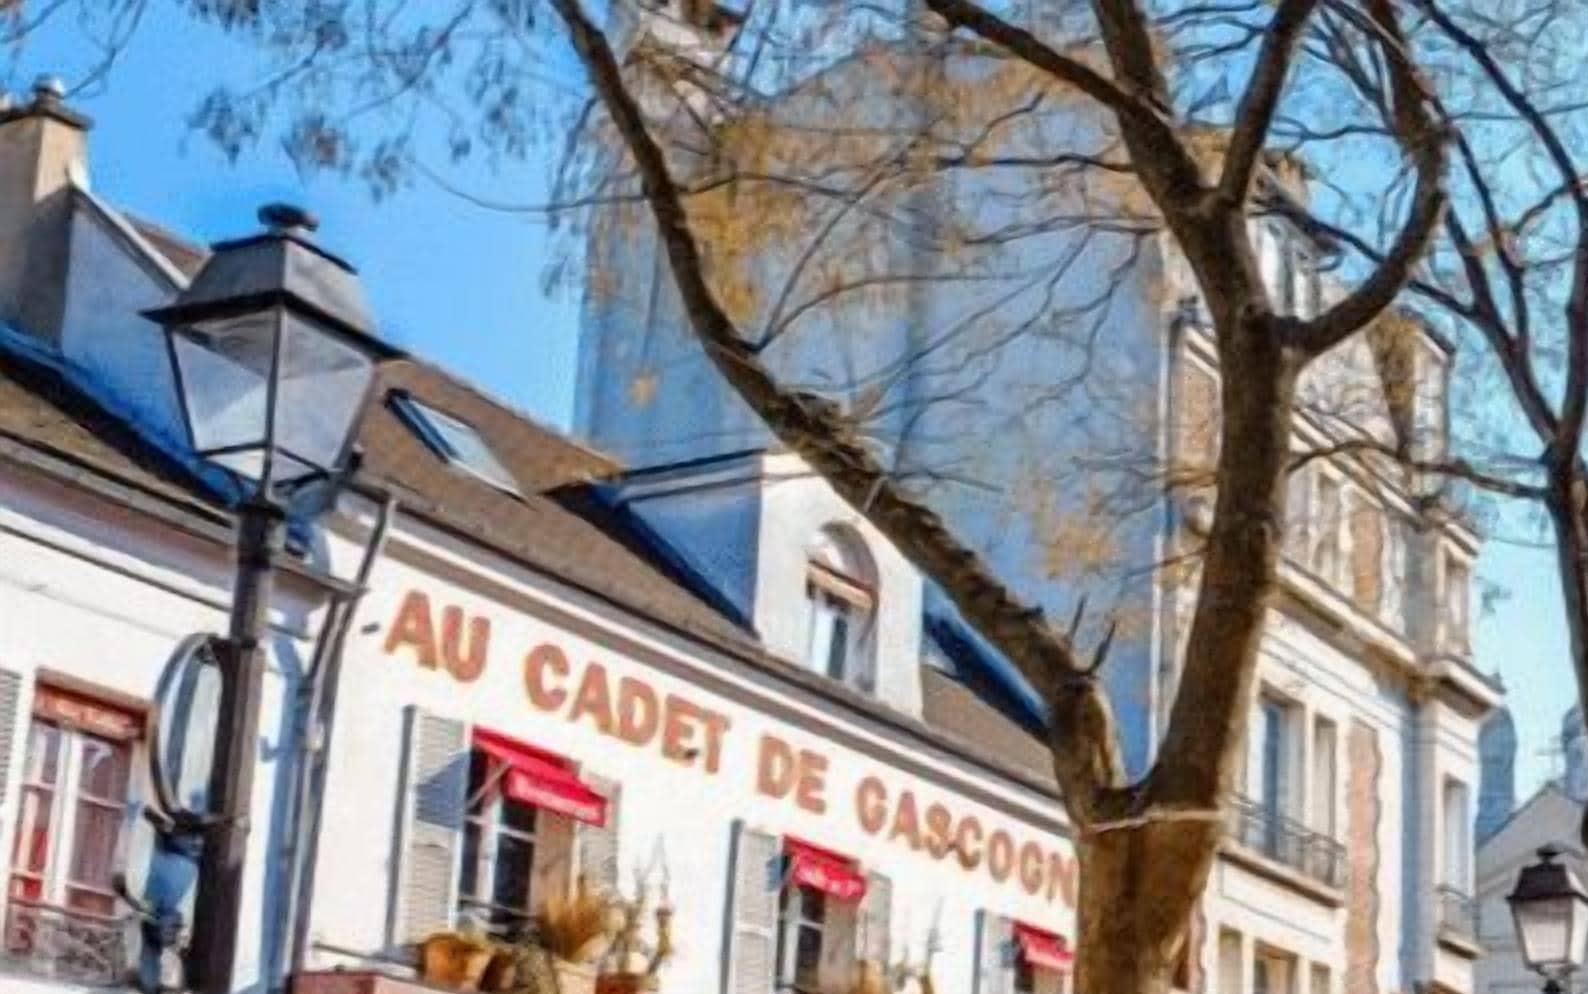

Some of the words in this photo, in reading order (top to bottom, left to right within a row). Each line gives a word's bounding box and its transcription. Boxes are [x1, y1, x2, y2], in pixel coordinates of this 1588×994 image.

[384, 588, 491, 683] AU
[523, 643, 730, 774] CADET
[756, 731, 829, 816] DE
[855, 776, 1081, 912] GASCOGN
